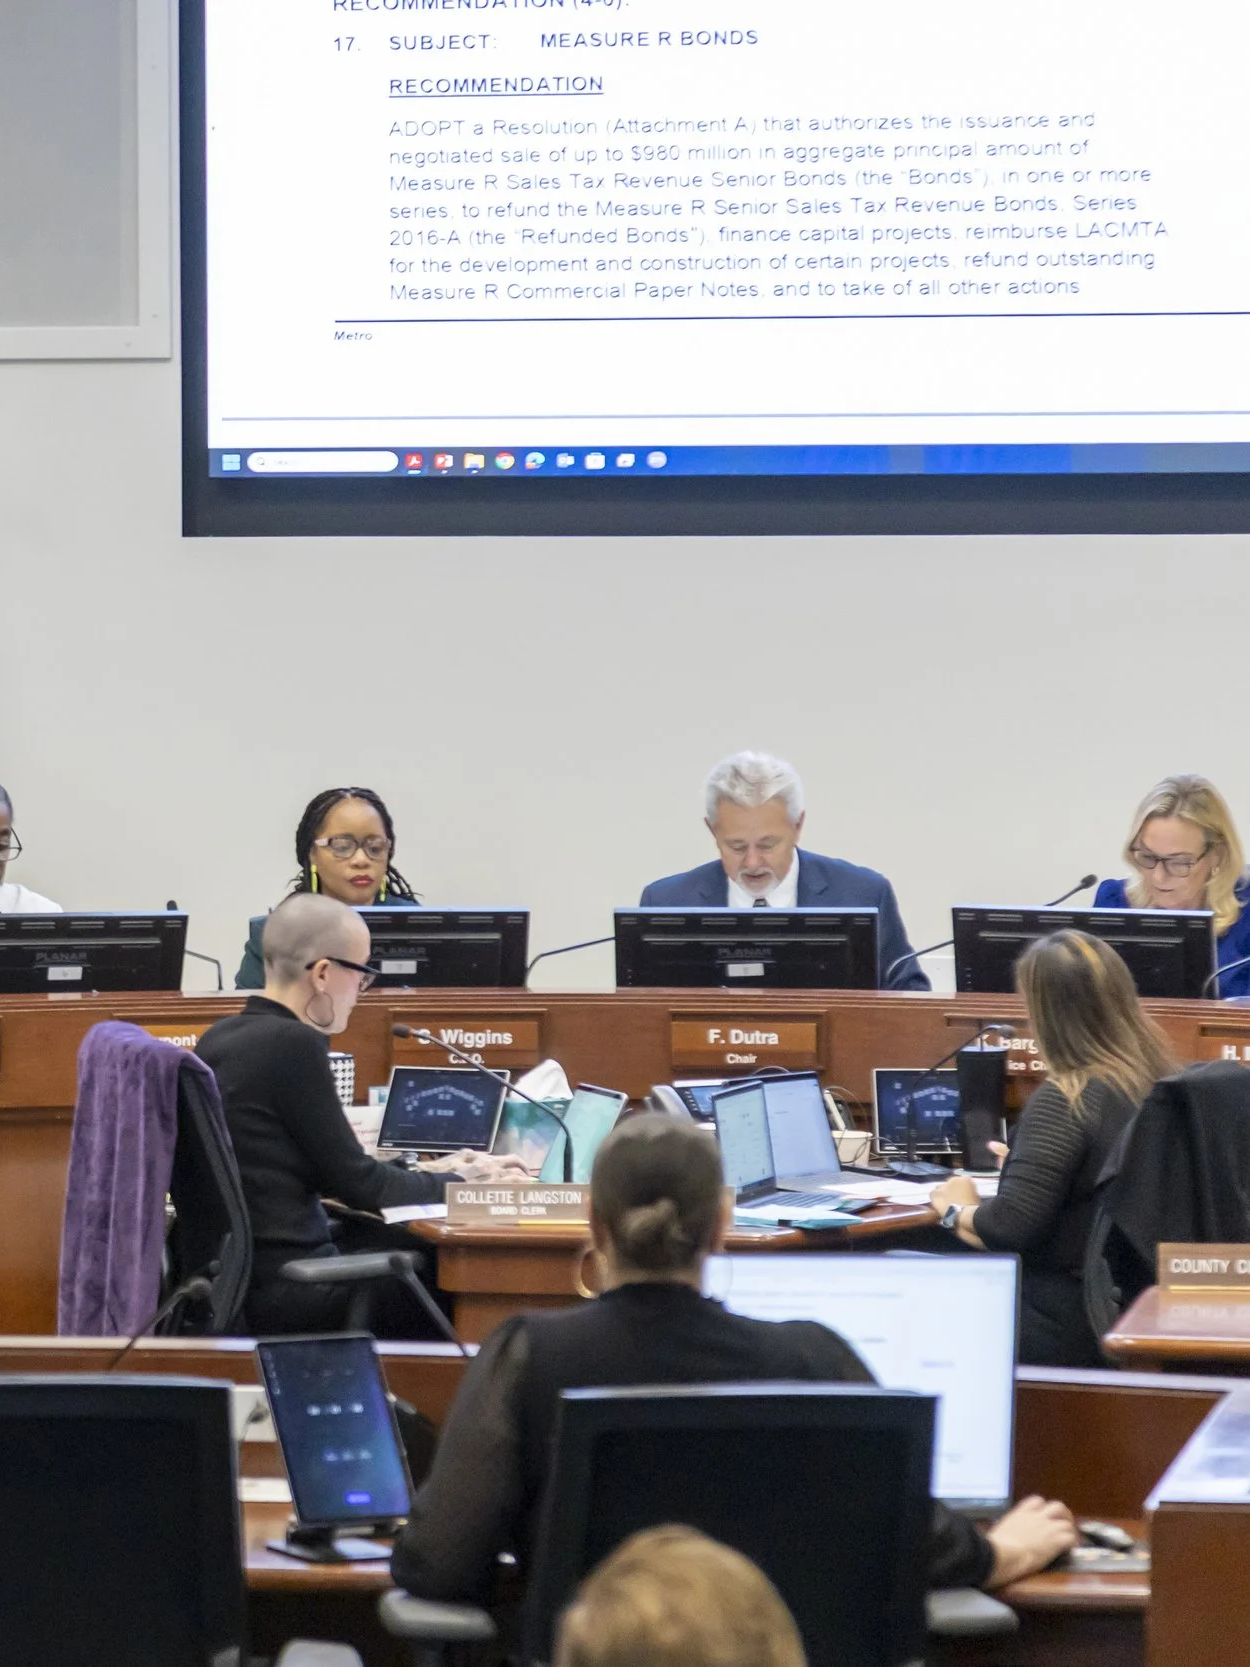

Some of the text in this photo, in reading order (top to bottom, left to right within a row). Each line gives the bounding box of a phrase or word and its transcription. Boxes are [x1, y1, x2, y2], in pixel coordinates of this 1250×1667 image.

[333, 29, 759, 53] 17. SUBJECT: MEASURE R BONDS
[389, 76, 604, 94] RECOMMENDATION
[388, 111, 1095, 137] ADOPT a Resolution (Attachment A) that authorizes the issuance and
[389, 138, 1090, 169] negotiated sale of up to $980 million in aggregate principal amount of
[389, 175, 476, 192] Measure
[484, 174, 499, 190] R
[506, 174, 562, 191] Sales
[569, 172, 605, 190] Tax
[613, 171, 703, 189] Revenue
[711, 170, 777, 188] Senior
[783, 169, 847, 187] Bonds
[855, 170, 893, 186] (the
[1002, 167, 1020, 184] in
[1026, 170, 1065, 184] one
[1071, 169, 1092, 183] or
[1099, 169, 1152, 183] more
[461, 202, 481, 219] to
[487, 201, 550, 219] refund
[557, 200, 589, 217] the
[595, 199, 683, 217] Measure
[690, 199, 706, 216] R
[713, 198, 778, 216] Senior
[785, 197, 843, 215] Sales
[849, 196, 887, 214] Tax
[894, 195, 986, 213] Revenue
[1073, 193, 1138, 212] Series
[389, 229, 462, 247] 2016-A
[468, 228, 506, 245] (the
[718, 225, 792, 243] finance
[798, 225, 865, 245] capital
[965, 223, 1068, 240] reimburse
[1075, 221, 1169, 239] LACMTA
[389, 257, 415, 274] for
[421, 257, 453, 274] the
[459, 256, 589, 277] development
[595, 256, 633, 272] and
[639, 255, 762, 272] construction
[769, 253, 789, 271] of
[794, 253, 863, 270] certain
[964, 250, 1029, 268] refund
[1035, 250, 1155, 271] outstanding
[390, 283, 476, 301] Measure
[484, 283, 499, 300] R
[506, 282, 626, 300] Commercial
[634, 280, 694, 302] Paper
[772, 281, 811, 298] and
[817, 280, 836, 297] to
[841, 280, 886, 297] take
[892, 278, 913, 296] of
[918, 279, 941, 296] all
[948, 279, 1001, 296] other
[1007, 279, 1081, 295] actions
[333, 330, 373, 341] Metro
[439, 1028, 514, 1049] Wiggins
[708, 1028, 779, 1045] F. Dutra
[726, 1053, 758, 1064] Chair
[456, 1190, 582, 1204] COLLETTE LANGSTON
[520, 1206, 548, 1216] CLERK
[1170, 1258, 1231, 1274] COUNTY
